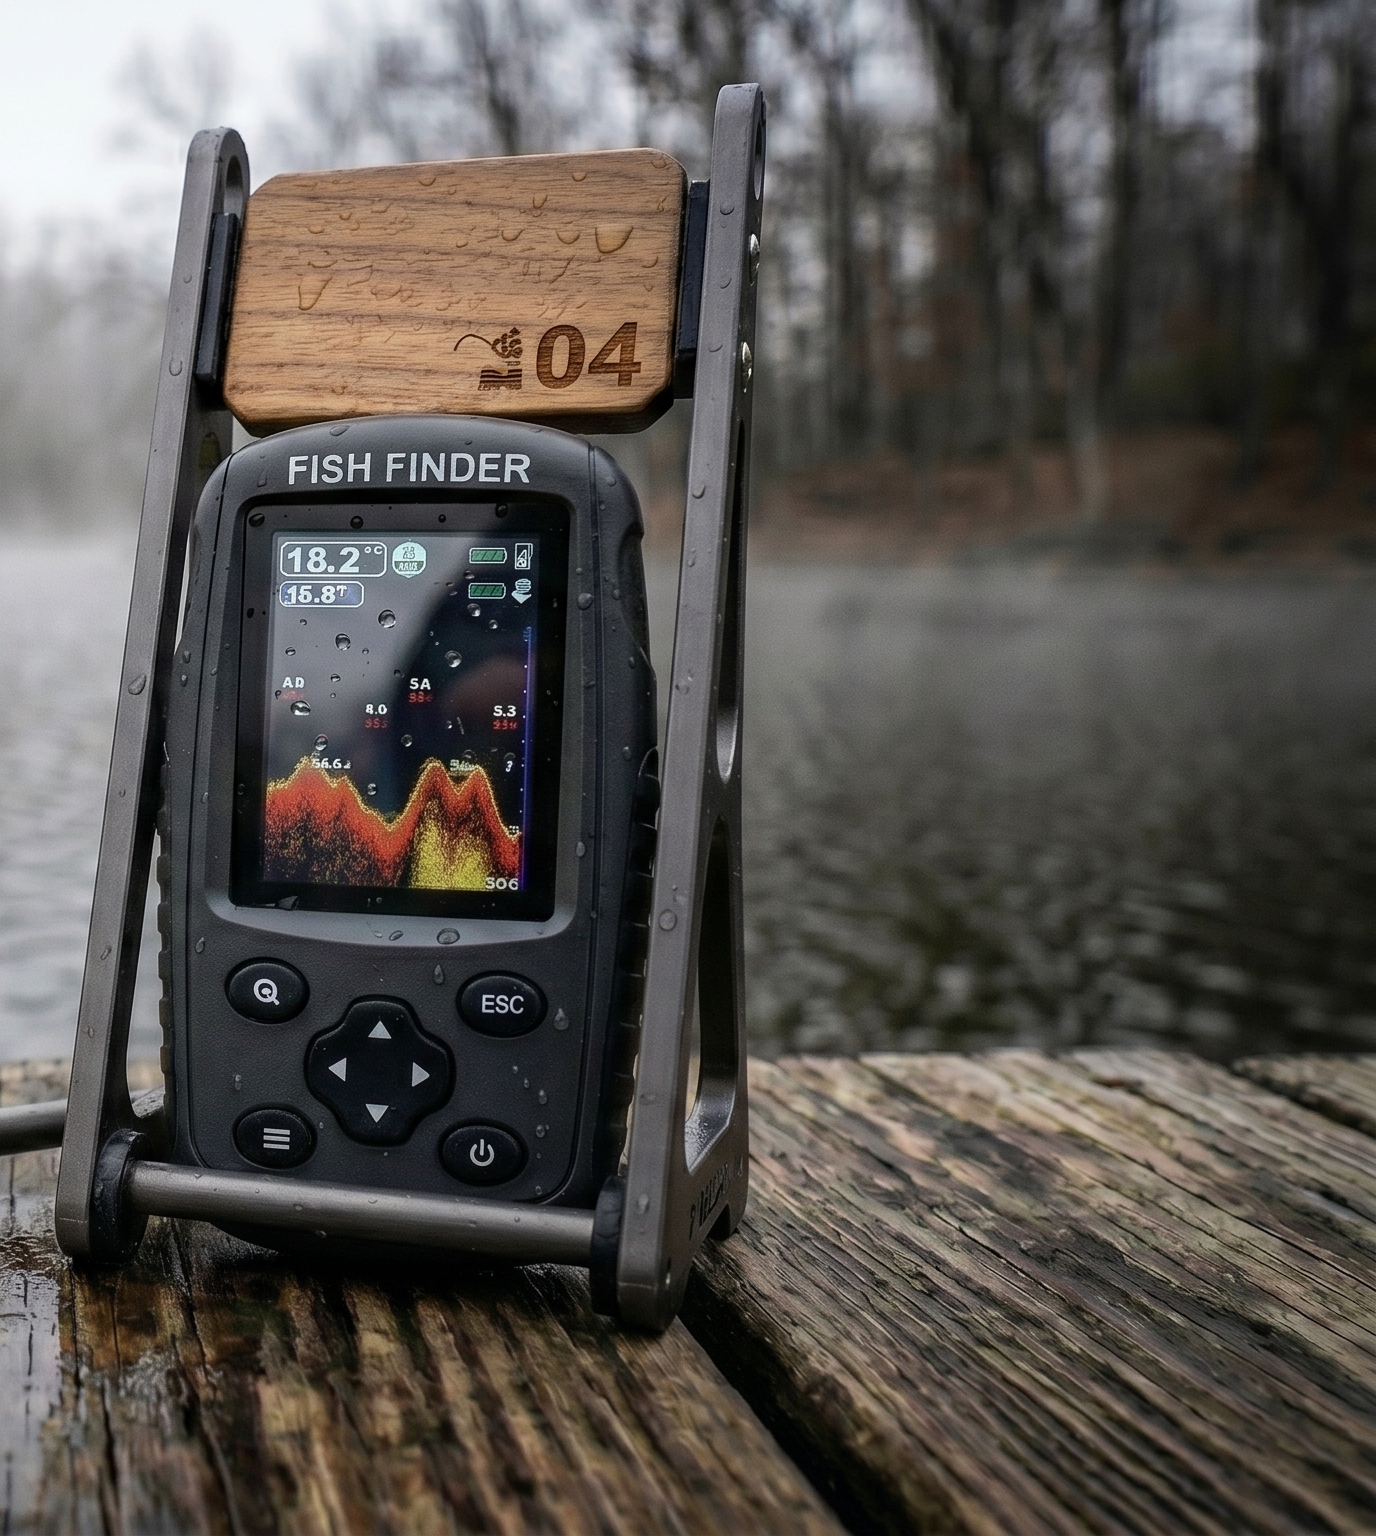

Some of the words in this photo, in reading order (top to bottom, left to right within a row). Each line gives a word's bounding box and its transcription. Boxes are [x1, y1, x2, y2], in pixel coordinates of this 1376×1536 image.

[536, 322, 642, 389] 04
[288, 452, 372, 485] FISH
[386, 452, 531, 484] FINDER
[482, 994, 524, 1014] ESC
